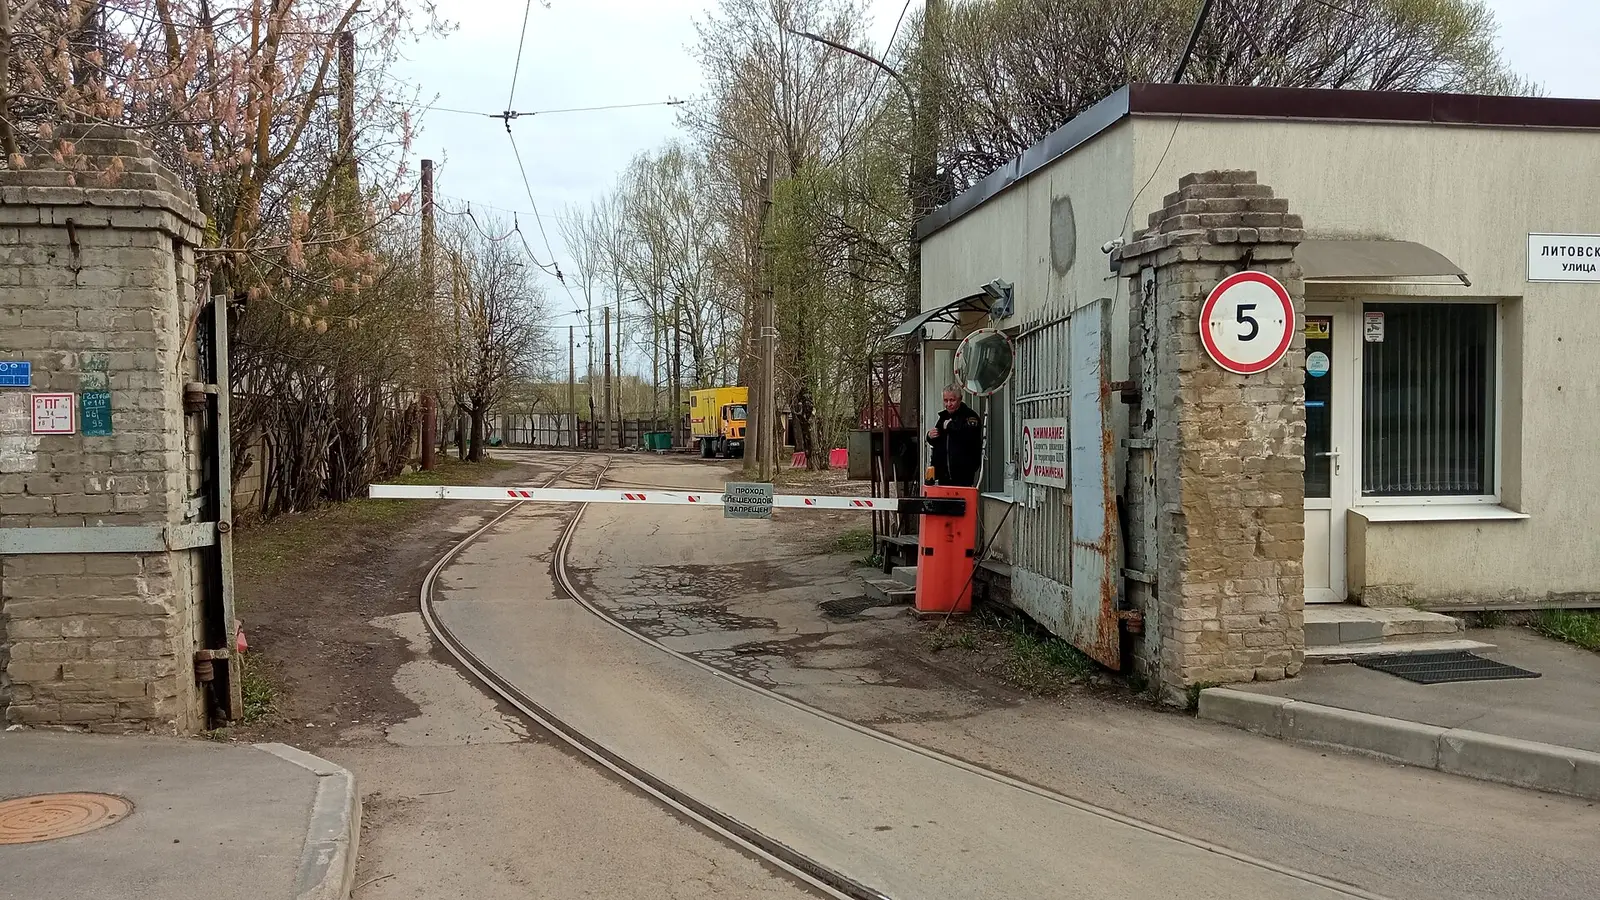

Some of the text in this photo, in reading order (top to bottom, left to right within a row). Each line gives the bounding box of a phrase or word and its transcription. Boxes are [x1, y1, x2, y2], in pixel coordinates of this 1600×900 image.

[1541, 245, 1600, 257] ЛИТОВСК
[1562, 263, 1597, 273] УЛИЦА
[1236, 303, 1259, 342] 5
[45, 399, 59, 409] ПГ
[1033, 427, 1065, 440] ВНИМАНИЕ!
[1024, 440, 1029, 464] 5
[1033, 465, 1064, 480] ОГРАНИЧЕНА
[735, 487, 764, 495] ПРОХОД
